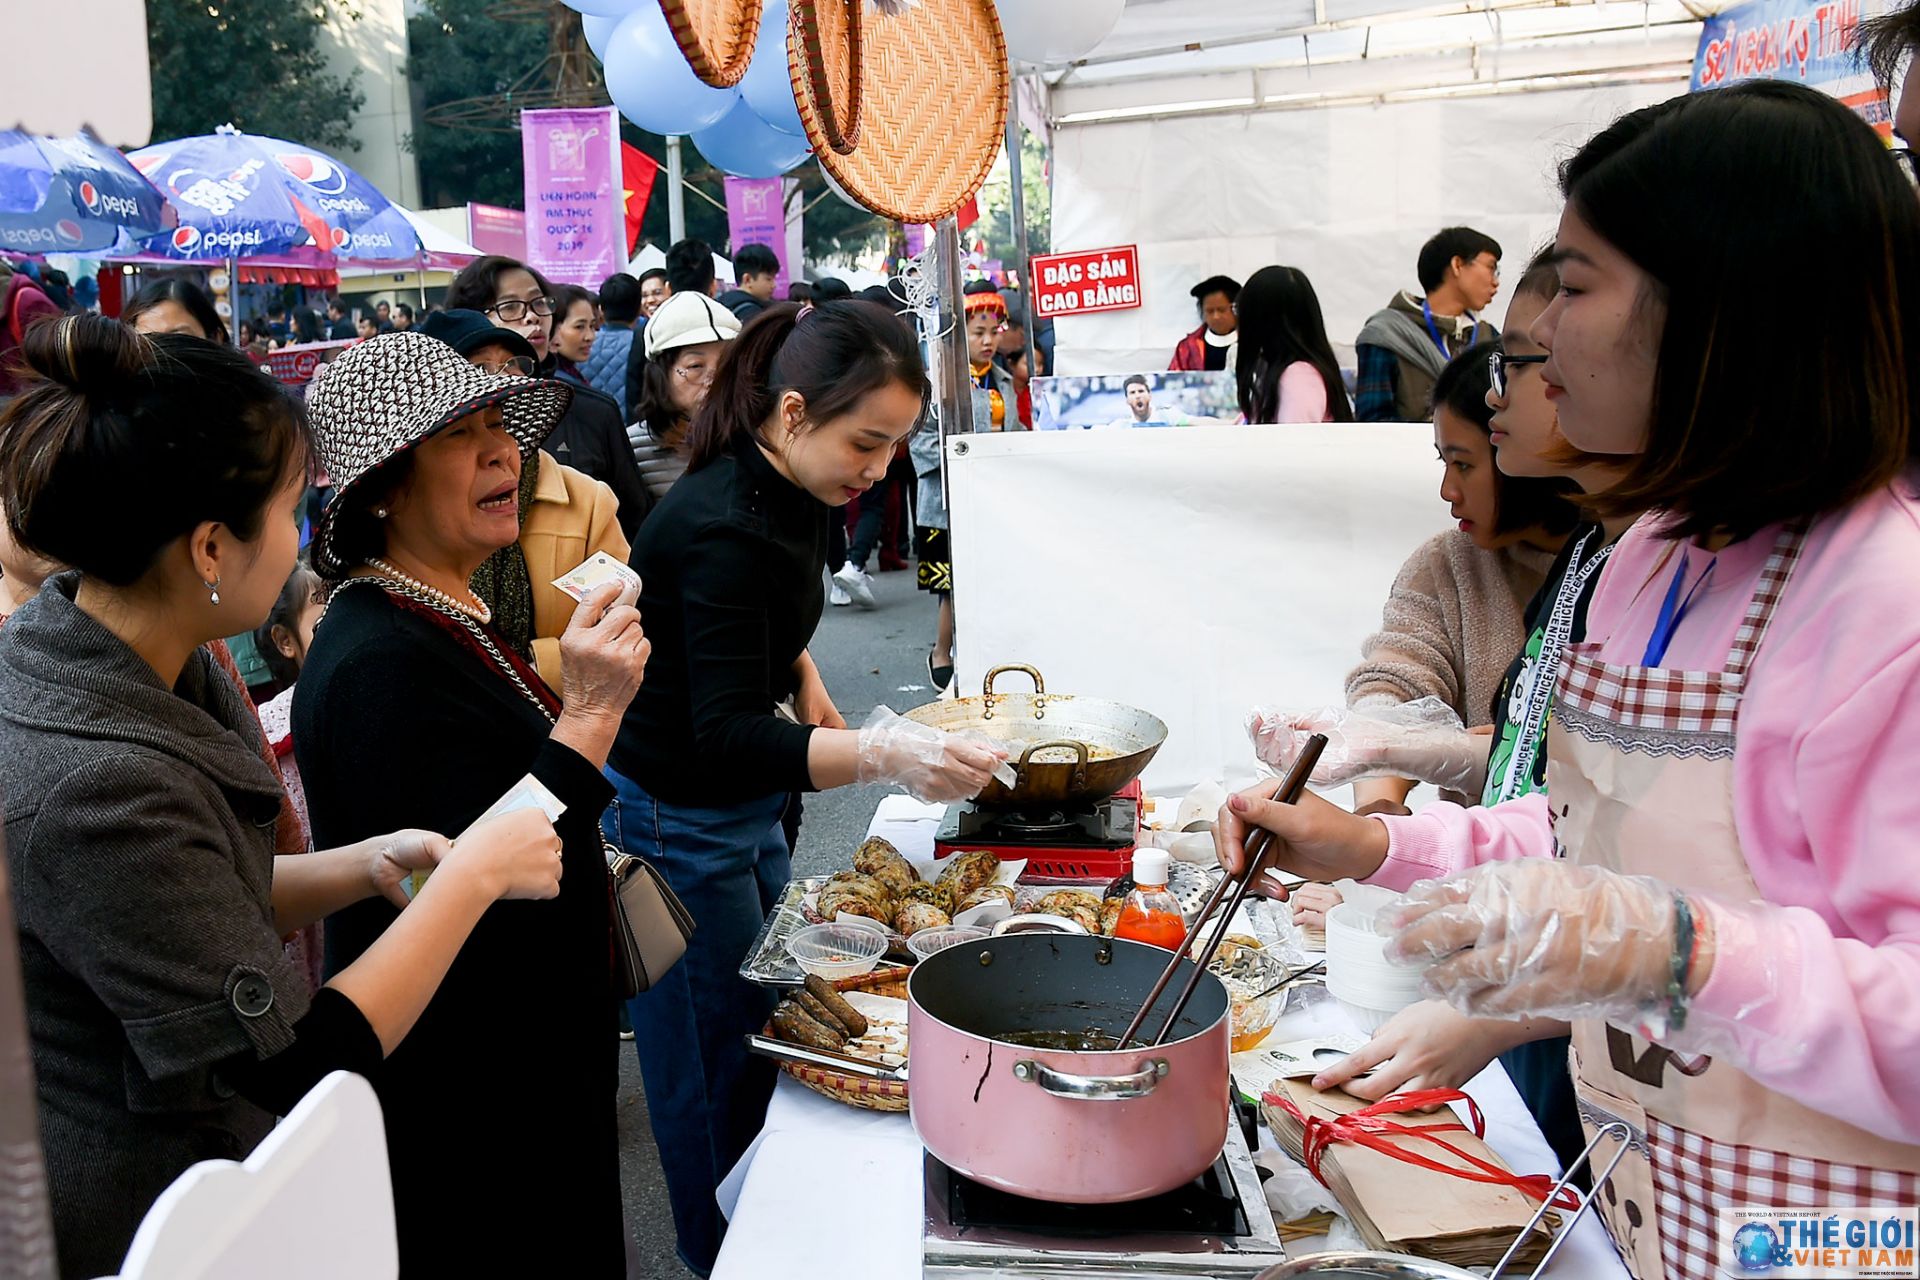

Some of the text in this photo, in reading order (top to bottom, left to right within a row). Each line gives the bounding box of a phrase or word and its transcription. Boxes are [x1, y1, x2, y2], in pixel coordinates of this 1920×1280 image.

[101, 194, 140, 217] pepsi
[318, 197, 370, 213] pepsi
[203, 229, 261, 252] pepsi
[352, 231, 392, 249] pepsi
[1044, 254, 1127, 287] ĐẶC SẢN
[1041, 281, 1135, 312] CAO BẰNG
